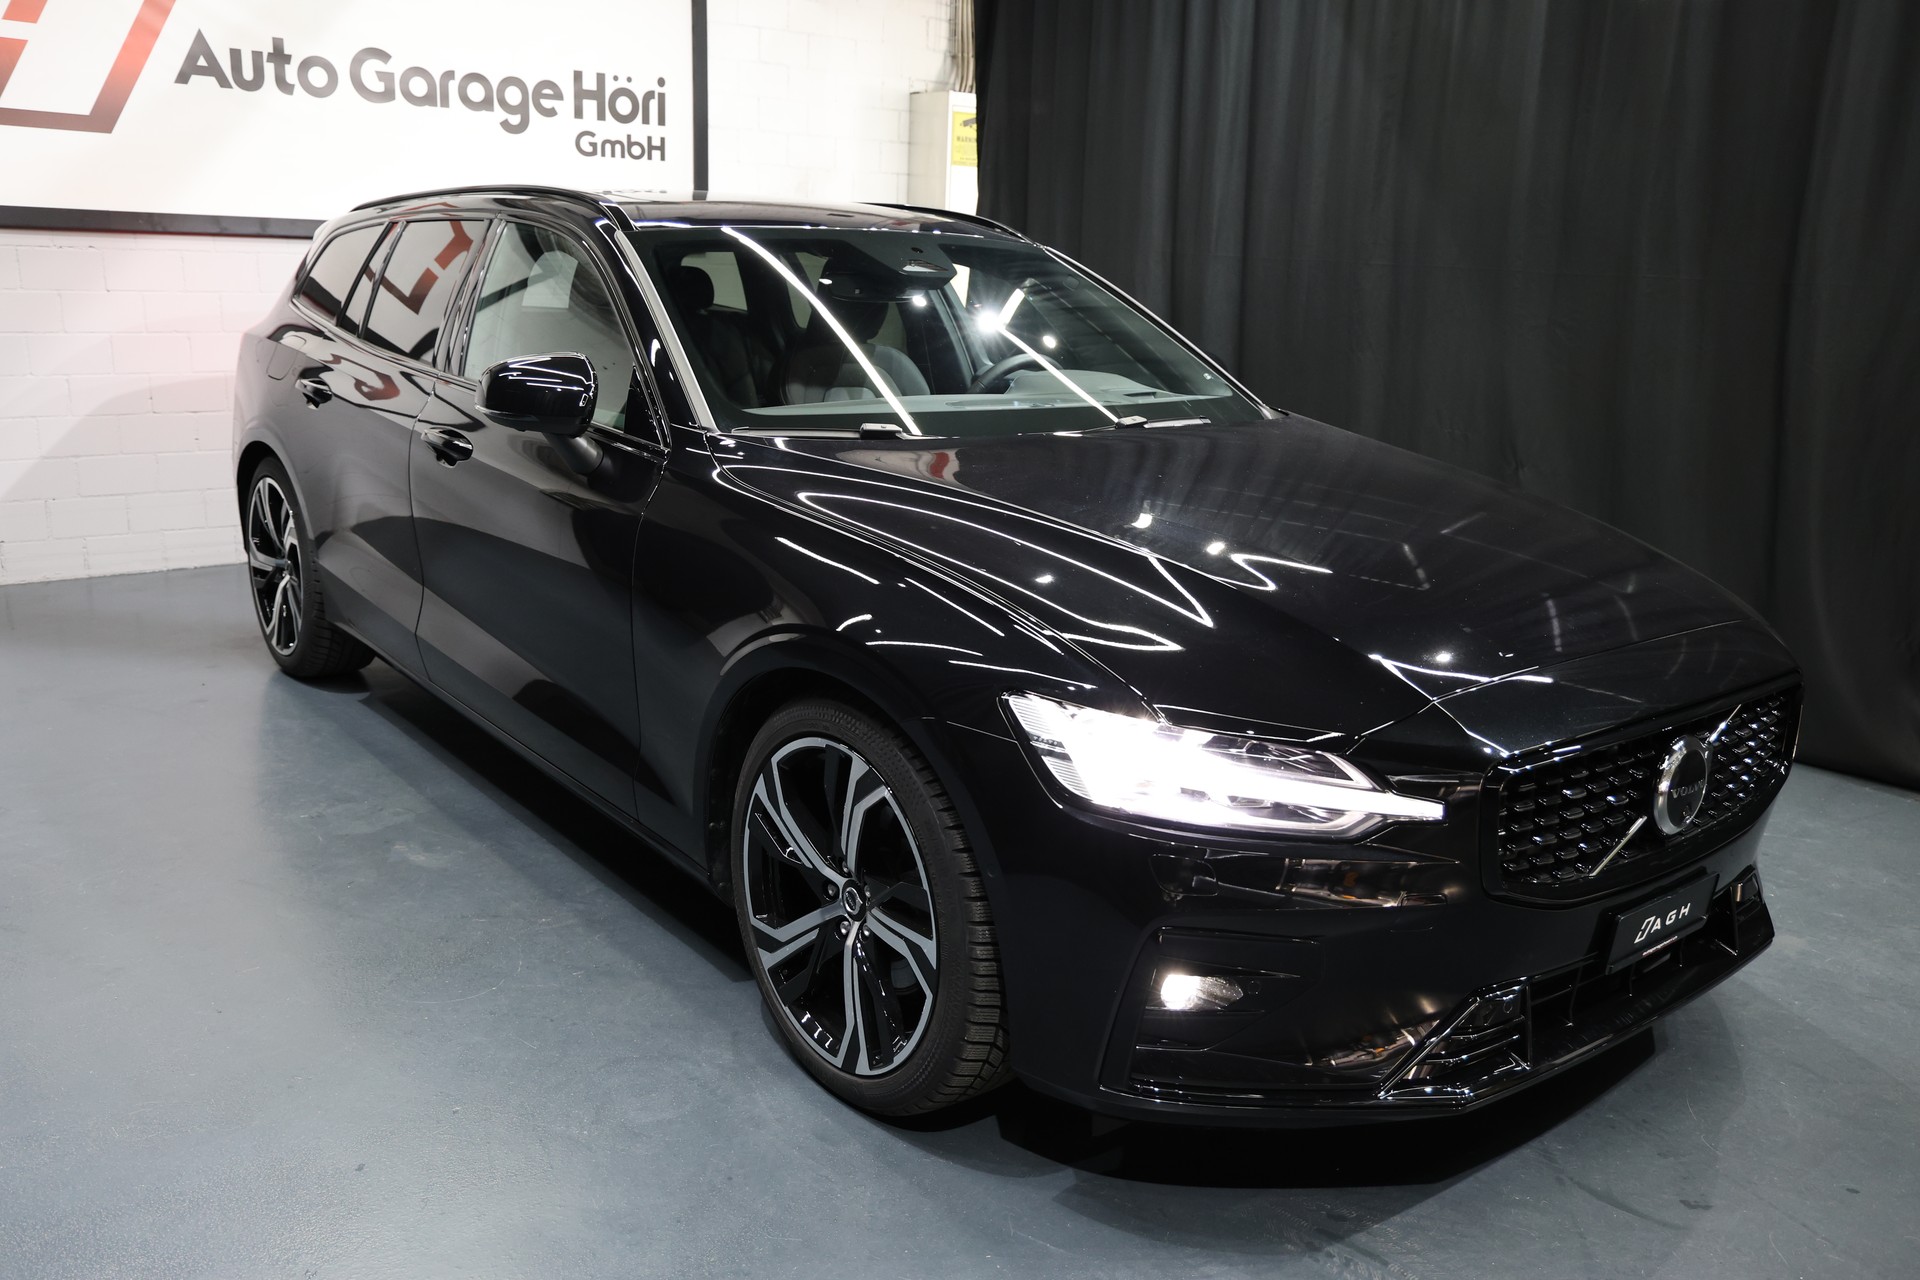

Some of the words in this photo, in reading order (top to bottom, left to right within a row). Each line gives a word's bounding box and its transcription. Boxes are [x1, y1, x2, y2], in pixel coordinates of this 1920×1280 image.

[174, 28, 338, 99] Auto
[349, 47, 564, 135] Garage
[573, 70, 666, 127] Höri
[574, 130, 666, 162] GmbH
